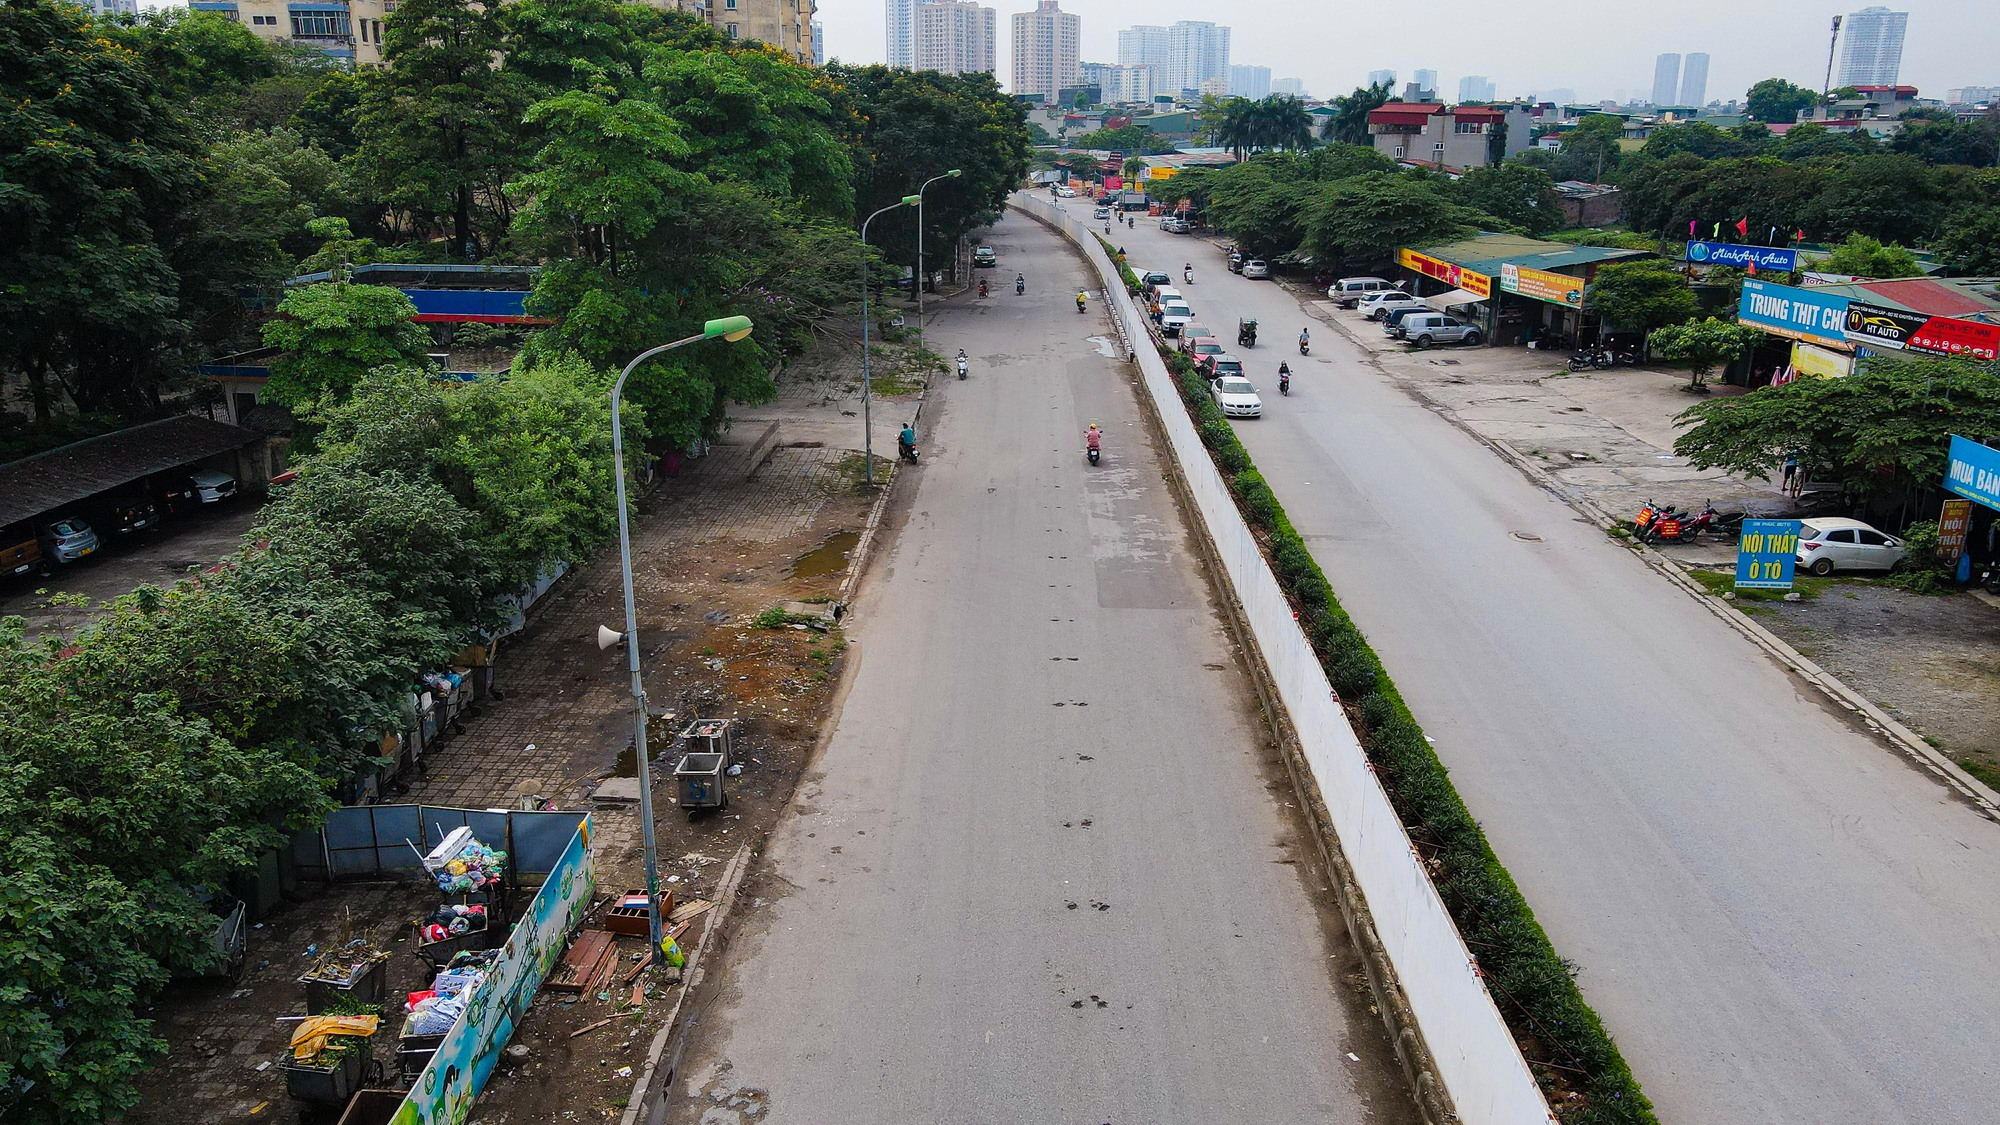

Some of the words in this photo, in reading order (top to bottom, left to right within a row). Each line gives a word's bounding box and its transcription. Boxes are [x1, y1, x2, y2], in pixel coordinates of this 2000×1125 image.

[1761, 253, 1788, 265] Auto
[1750, 293, 1789, 320] TRUNG
[1792, 301, 1820, 330] THỊT
[1867, 324, 1878, 333] HT
[1877, 328, 1899, 338] AUTO
[1949, 459, 1975, 486] MUA
[1976, 467, 2000, 497] BÁN
[1742, 530, 1764, 558] NỘI
[1767, 528, 1798, 553] THẤT
[1749, 559, 1760, 579] Ô
[1764, 559, 1782, 580] TÔ
